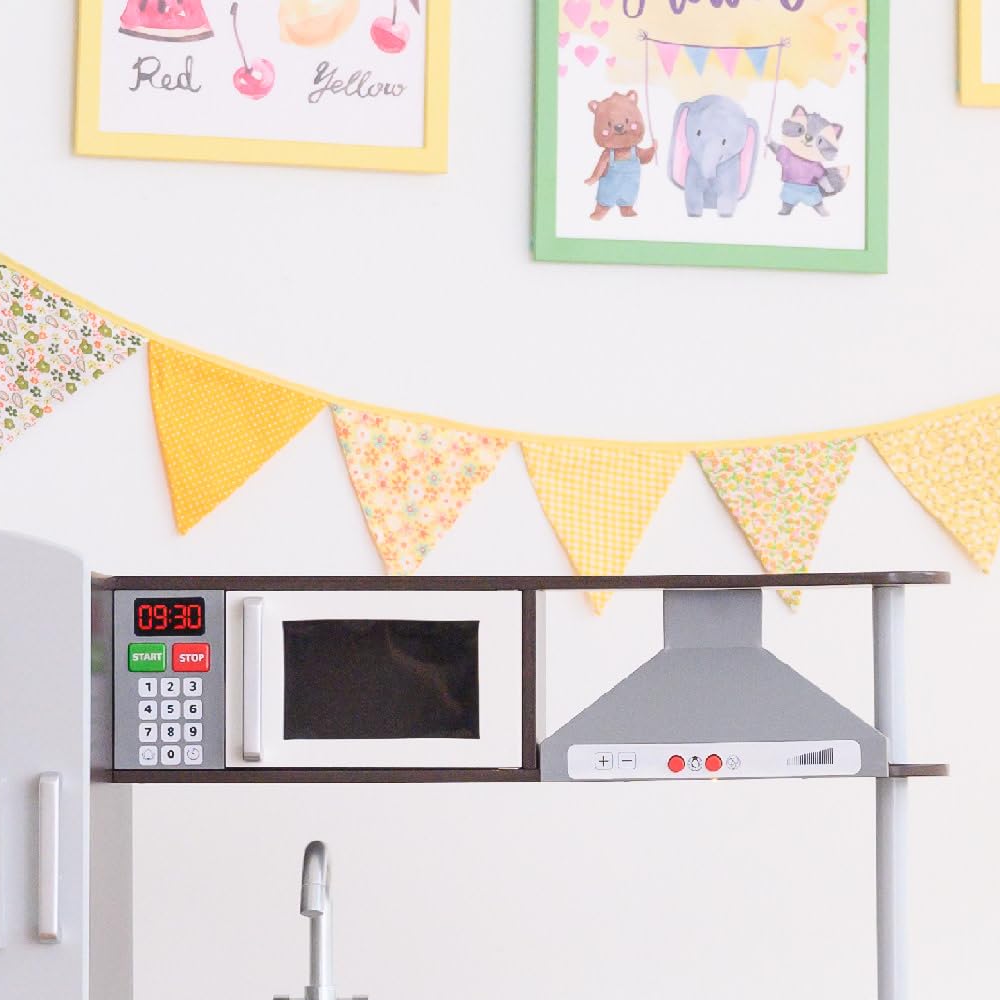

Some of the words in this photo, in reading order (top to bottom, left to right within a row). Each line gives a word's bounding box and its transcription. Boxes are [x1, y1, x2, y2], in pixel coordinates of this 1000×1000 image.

[128, 56, 201, 93] Red
[308, 60, 406, 104] Yellow
[138, 604, 202, 630] 09:30
[132, 652, 163, 662] START
[179, 653, 205, 663] STOP
[145, 682, 151, 692] 1
[167, 682, 174, 692] 2
[189, 681, 197, 692] 3
[144, 704, 152, 714] 4
[167, 704, 174, 714] 5
[189, 704, 197, 714] 6
[144, 727, 152, 737] 7
[167, 727, 175, 737] 8
[189, 726, 197, 737] 9
[167, 749, 175, 759] 0
